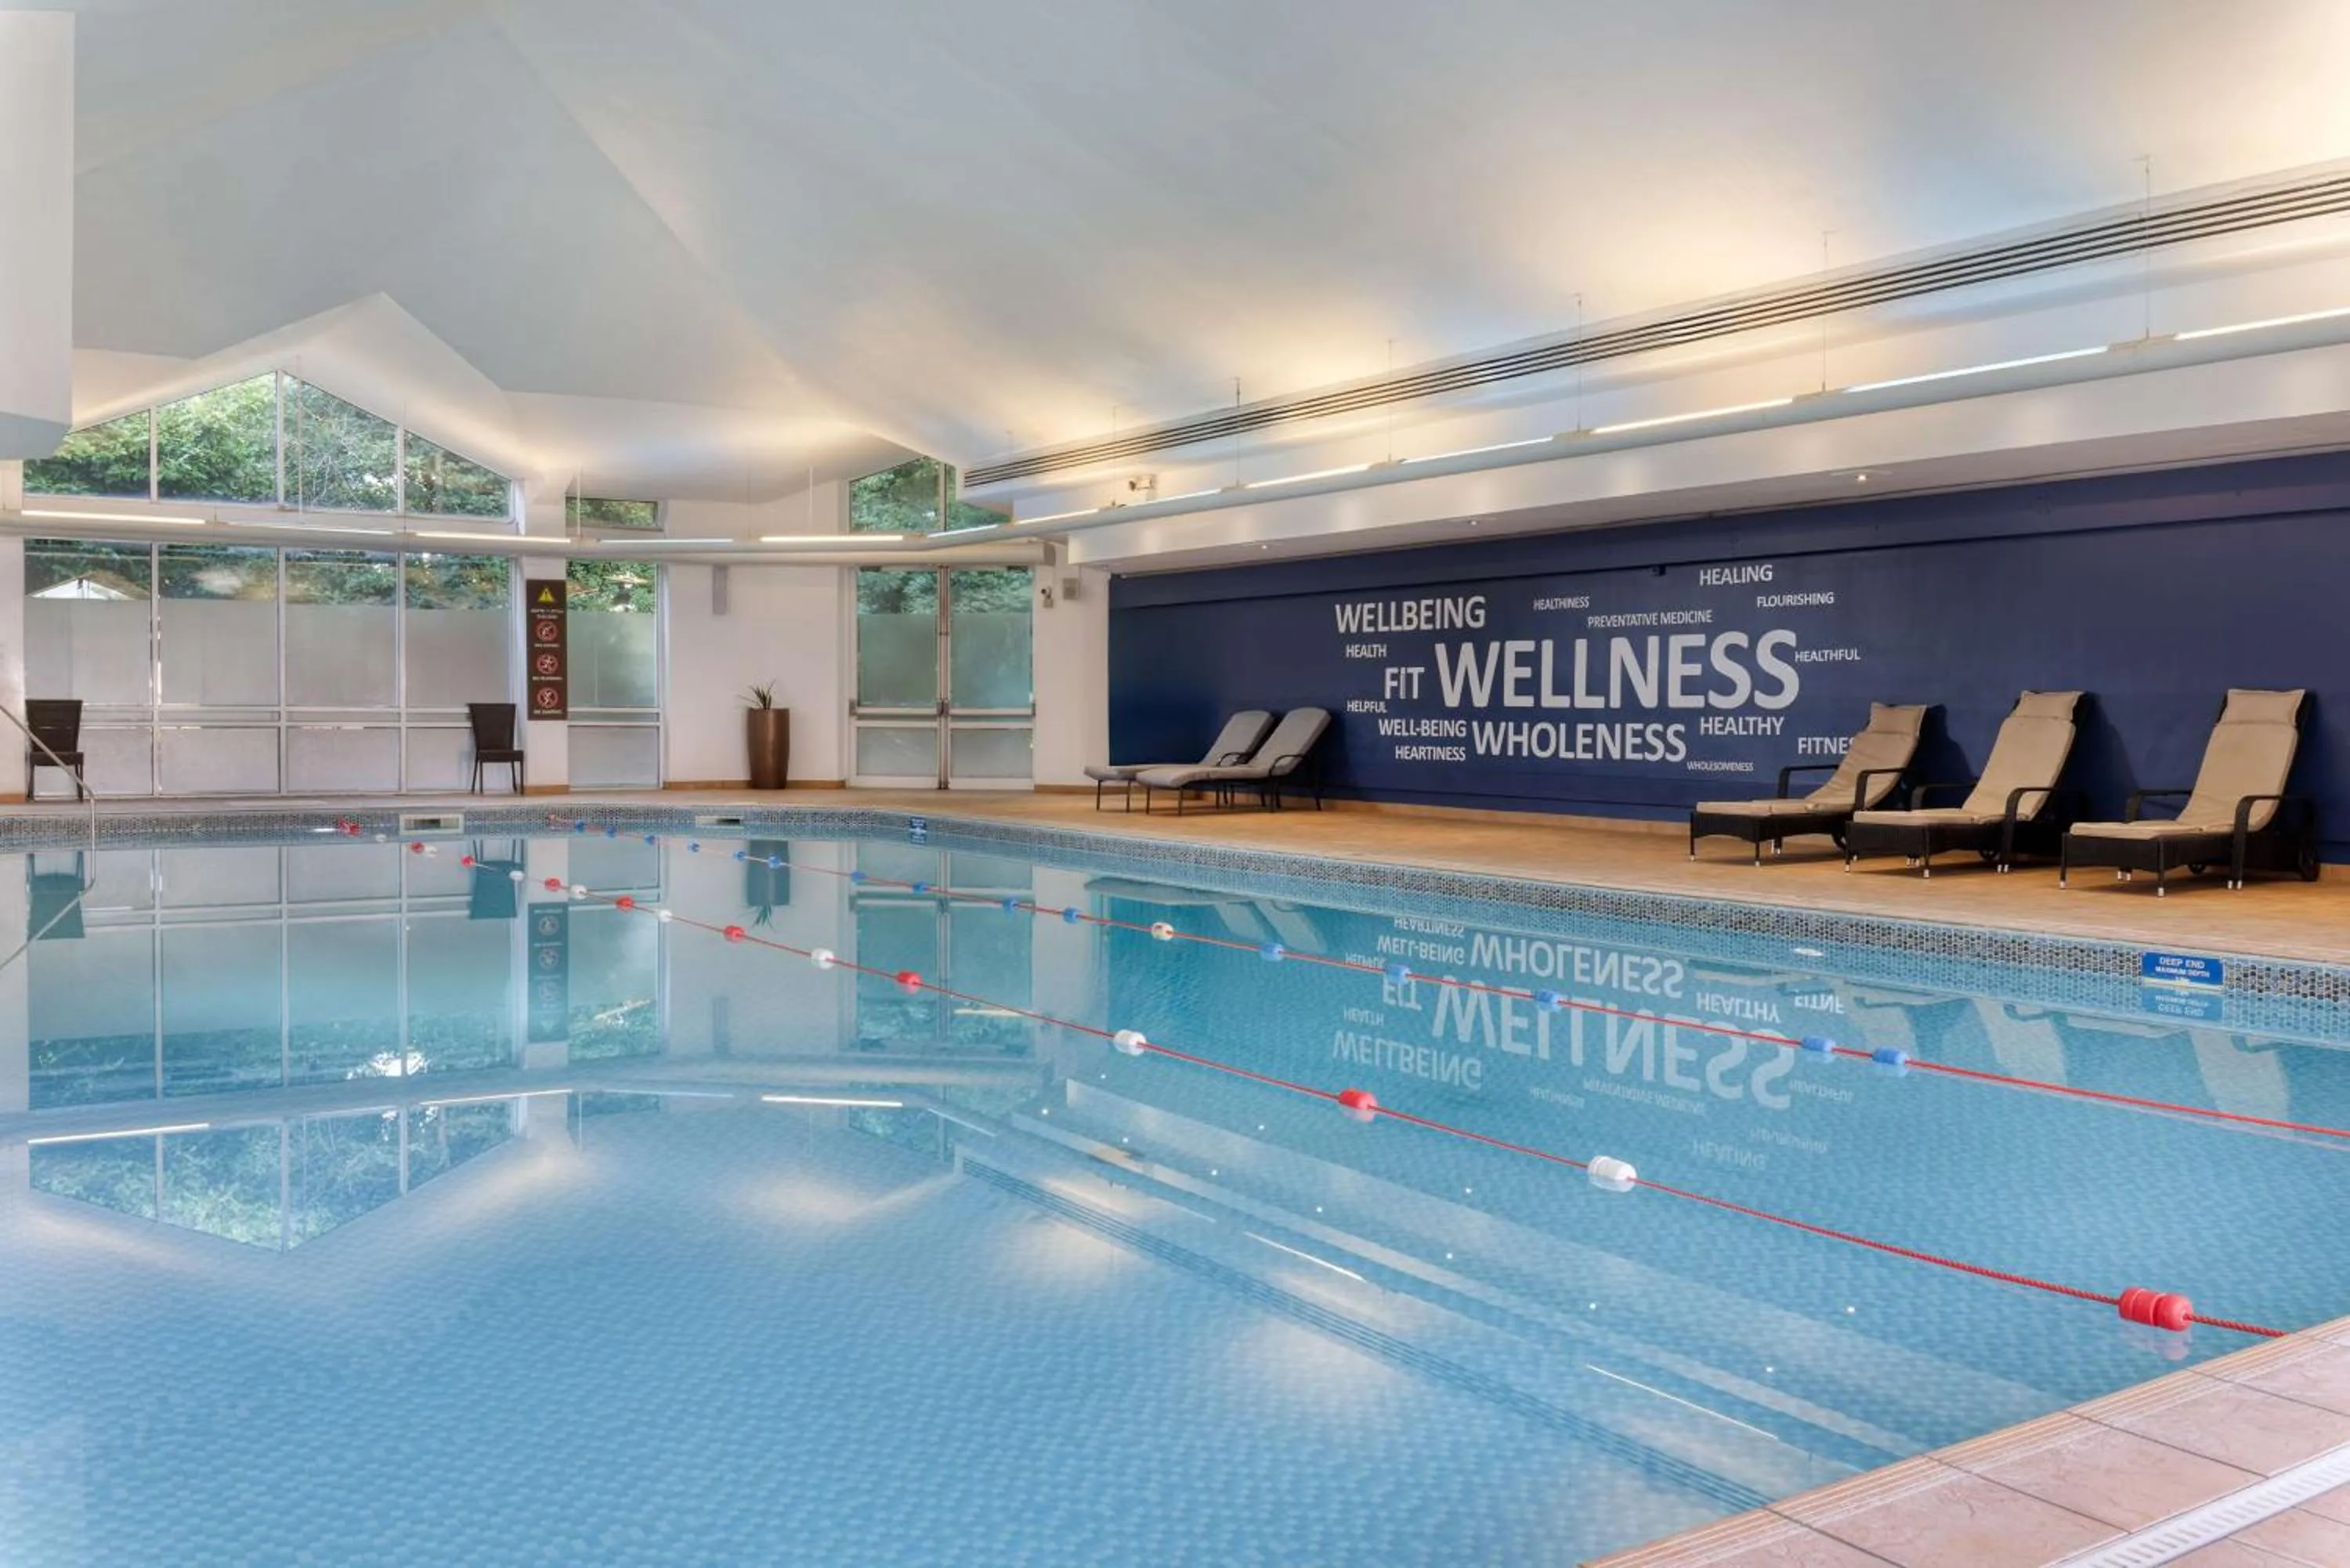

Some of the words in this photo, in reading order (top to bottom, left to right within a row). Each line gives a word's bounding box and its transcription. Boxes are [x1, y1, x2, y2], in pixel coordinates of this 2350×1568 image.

[1699, 564, 1773, 586] HEALING
[1533, 596, 1590, 611] HEALTHINESS
[1756, 591, 1835, 608] FLOURISHING
[1335, 596, 1486, 634] WELLBEING
[1587, 613, 1658, 627] PREVENTATIVE
[1660, 609, 1713, 625] MEDICINE
[1346, 644, 1387, 659] HEALTH
[1795, 649, 1860, 663] HEALTHFUL
[1434, 629, 1800, 710] WELLNESS
[1384, 667, 1426, 699] FIT
[1347, 700, 1387, 714] HELPFUL
[1378, 718, 1467, 737] WELL-BEING
[1700, 717, 1785, 735] HEALTHY
[1472, 720, 1687, 762] WHOLENESS
[1395, 745, 1466, 761] HEARTINESS
[2159, 956, 2183, 966] DEEP
[2185, 959, 2205, 969] END
